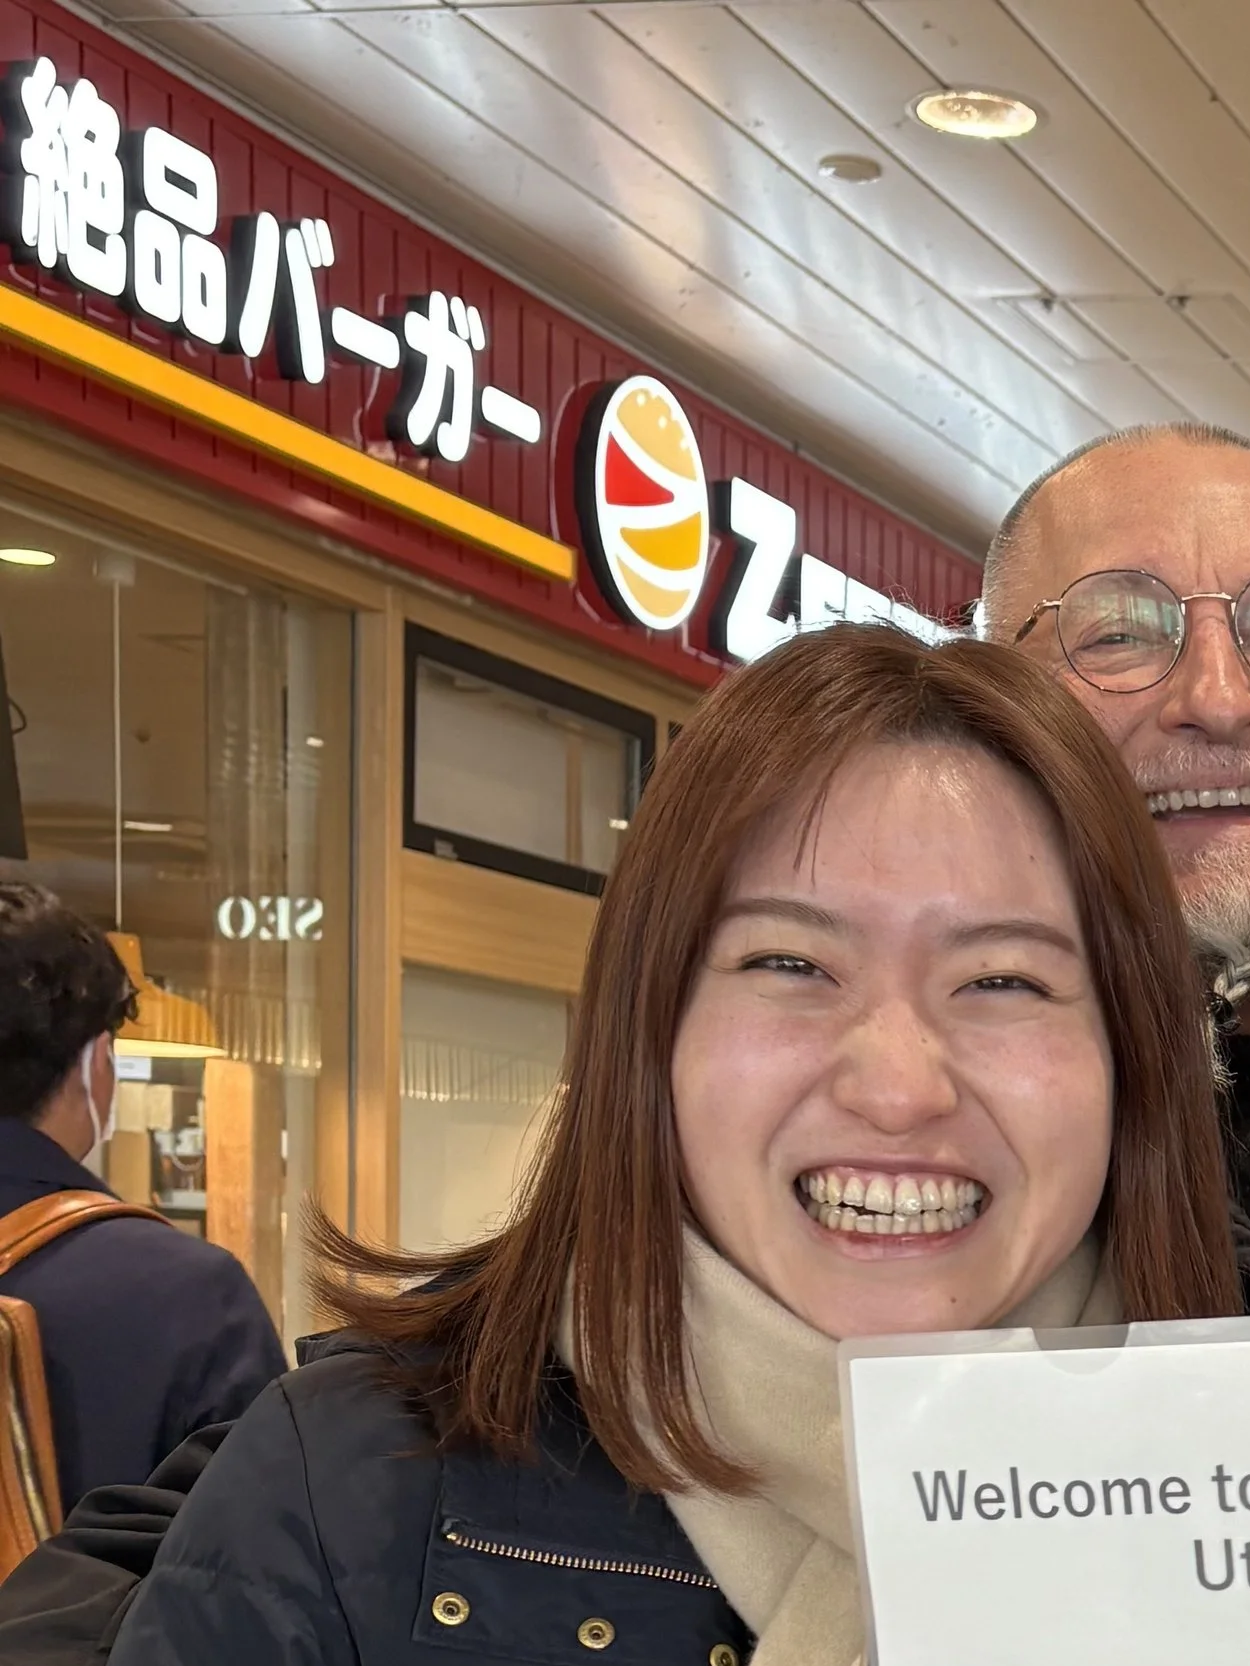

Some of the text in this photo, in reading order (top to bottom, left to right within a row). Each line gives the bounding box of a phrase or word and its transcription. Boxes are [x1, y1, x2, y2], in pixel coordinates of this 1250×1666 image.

[21, 56, 541, 462] 絶品バーガー
[911, 1465, 1192, 1523] Welcome
